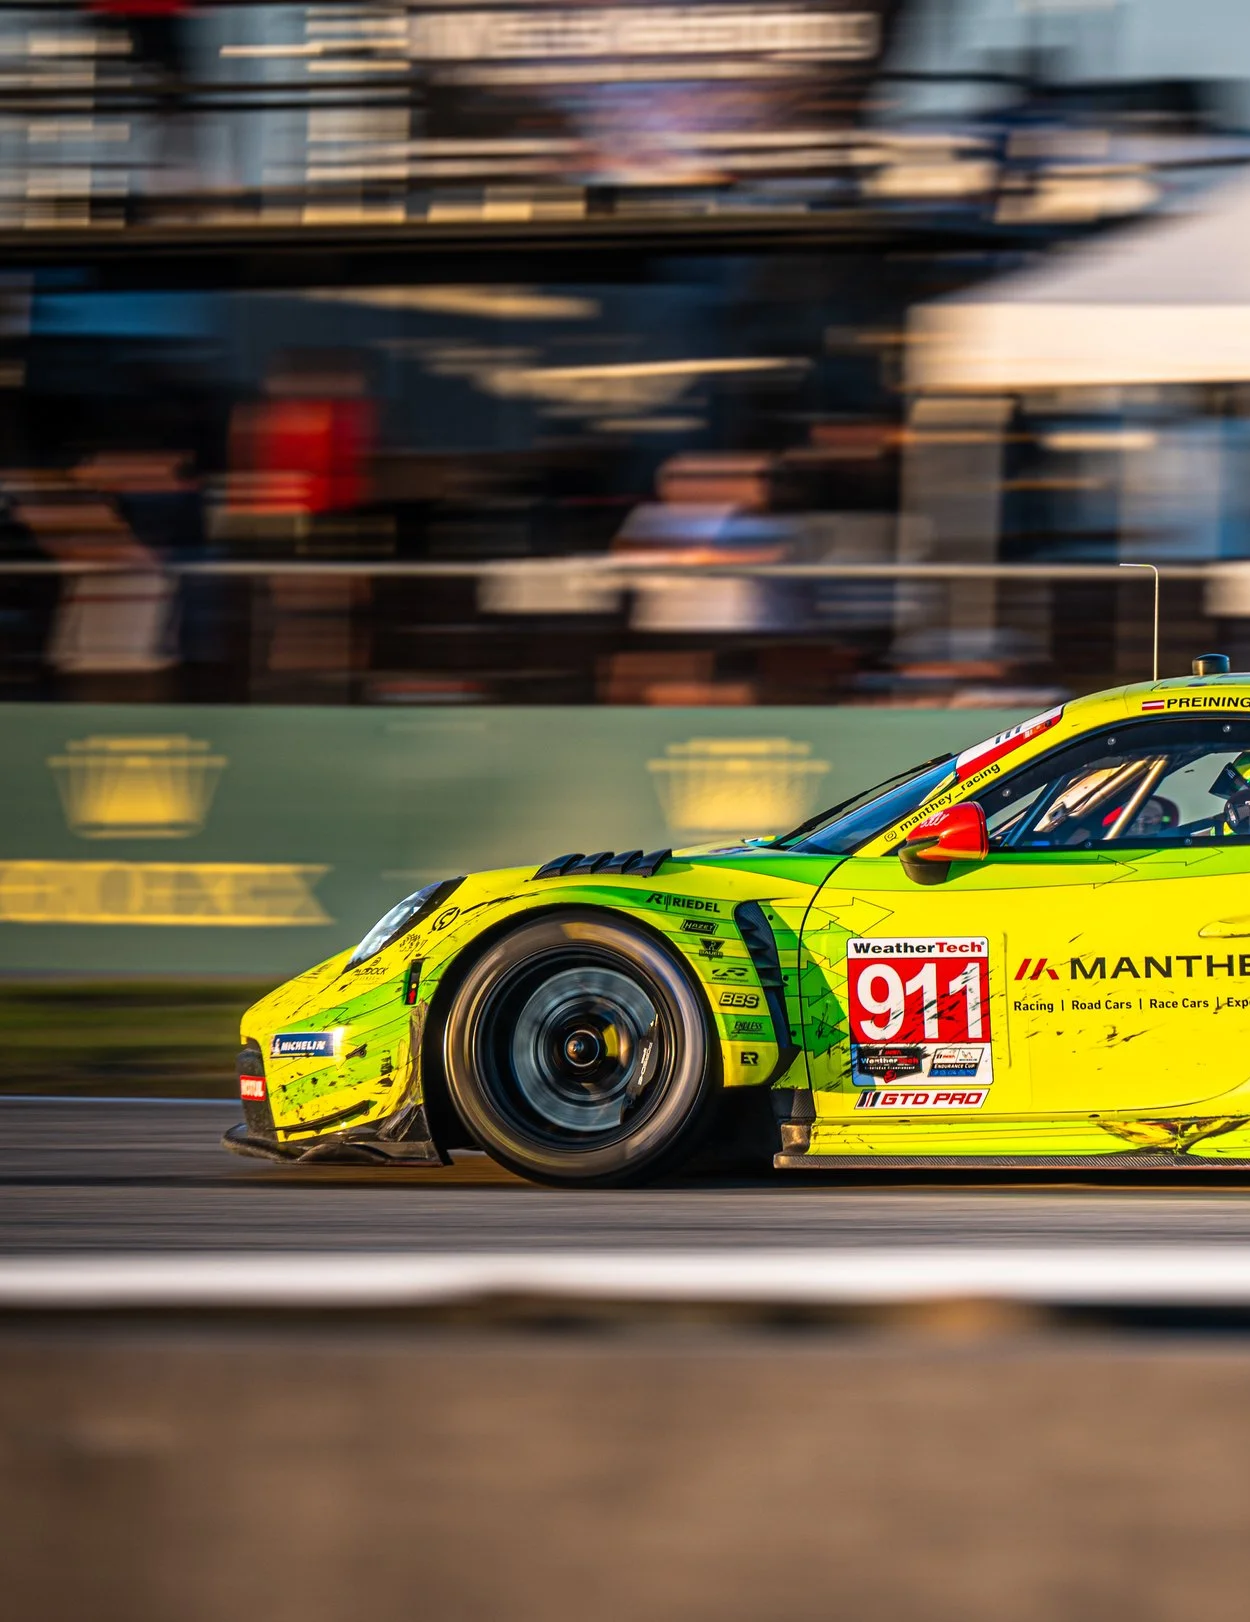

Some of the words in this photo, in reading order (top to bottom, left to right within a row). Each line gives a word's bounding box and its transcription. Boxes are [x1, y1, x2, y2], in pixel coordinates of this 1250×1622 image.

[899, 763, 1001, 832] manthey_racing
[672, 897, 721, 913] RIEDEL
[853, 941, 983, 954] WeatherTech
[719, 991, 760, 1009] BBS
[857, 963, 983, 1040] 911
[1013, 1000, 1054, 1013] Racing
[1071, 999, 1101, 1010] Road
[1104, 999, 1133, 1010] Cars
[1149, 998, 1179, 1009] Race
[1181, 997, 1210, 1008] Cars
[280, 1039, 327, 1051] MICHELIN
[880, 1092, 930, 1105] GTD
[932, 1092, 983, 1105] PRO
